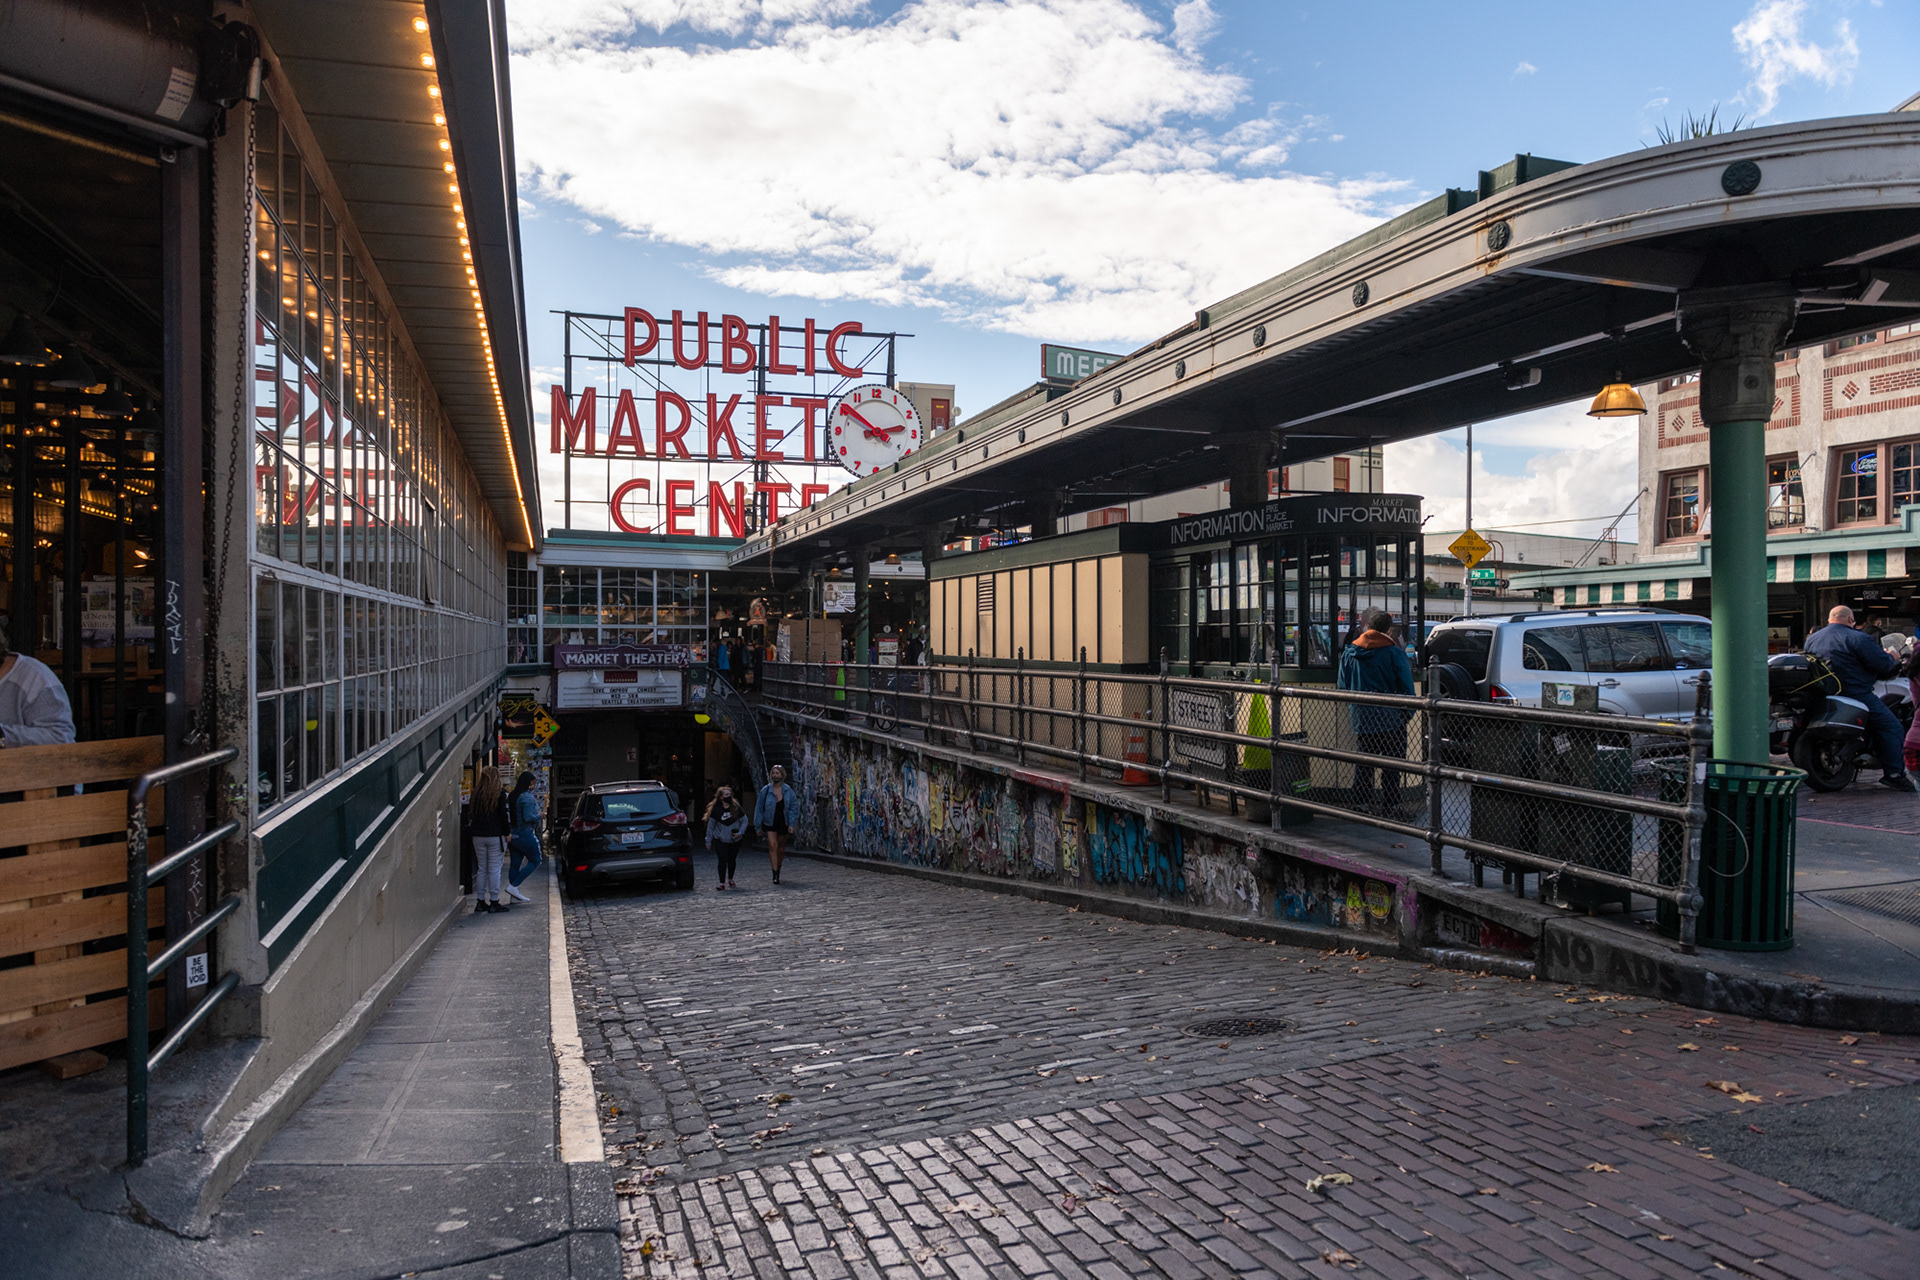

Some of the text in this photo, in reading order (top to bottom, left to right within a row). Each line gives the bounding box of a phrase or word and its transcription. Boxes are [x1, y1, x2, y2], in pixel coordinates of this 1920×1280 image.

[624, 306, 863, 378] PUBLIC
[854, 393, 861, 403] 11
[872, 389, 882, 398] 12
[893, 395, 897, 404] 1
[906, 410, 912, 419] 2
[551, 384, 828, 463] MARKET
[835, 426, 842, 435] 9
[911, 429, 917, 439] 3
[840, 446, 847, 456] 8
[854, 461, 861, 470] 7
[1371, 498, 1404, 507] MARKET
[1265, 512, 1287, 522] PLACE
[1170, 503, 1279, 544] INFORMATION PIKE
[1265, 520, 1294, 533] MARKET
[566, 653, 679, 665] MARKET THEATER
[1178, 699, 1215, 724] STREET
[193, 957, 202, 966] BE
[1548, 930, 1683, 994] NO ADS
[190, 965, 203, 974] THE
[188, 973, 206, 984] VOID
